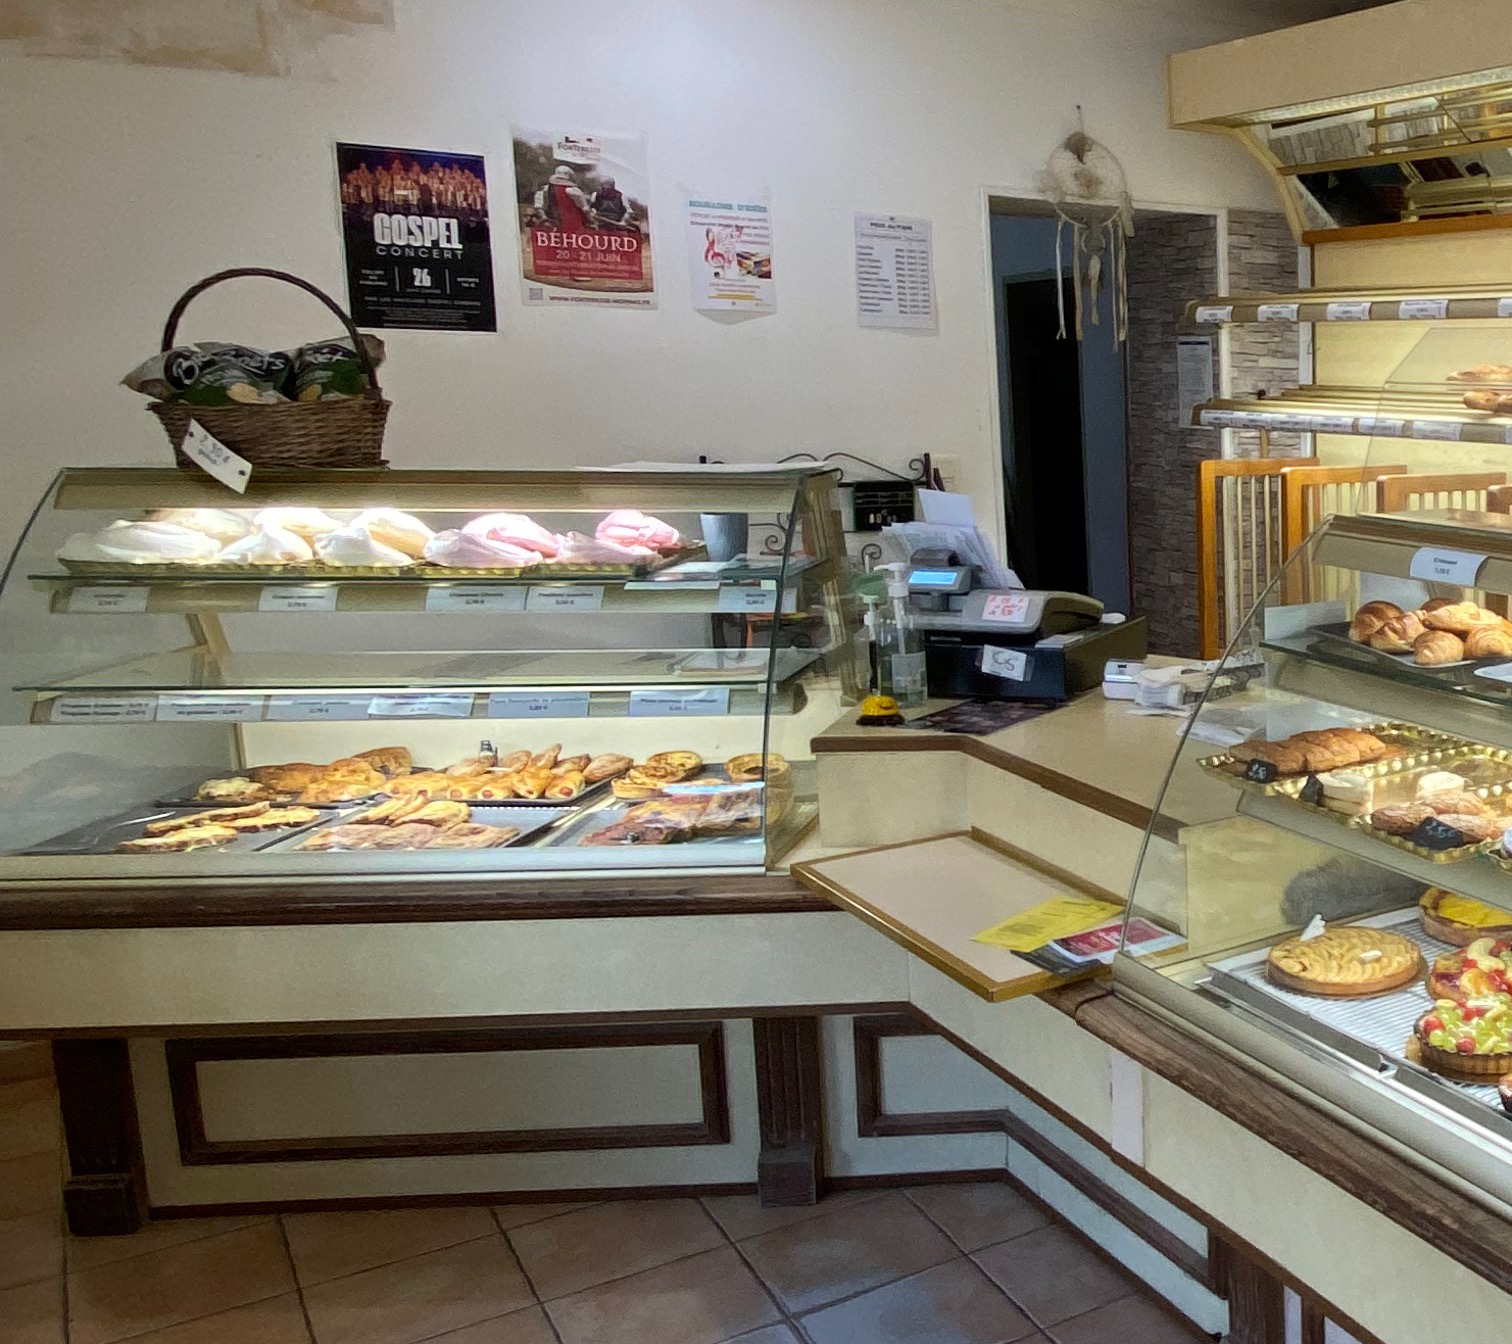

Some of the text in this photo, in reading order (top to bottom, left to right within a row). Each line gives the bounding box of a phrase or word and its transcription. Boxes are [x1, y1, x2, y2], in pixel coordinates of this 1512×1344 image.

[373, 212, 464, 249] GOSPEL
[536, 227, 638, 252] BÉHOURD
[376, 246, 464, 260] CONCERT
[556, 250, 570, 260] 20
[579, 251, 591, 261] 21
[596, 252, 621, 263] JUIN
[412, 267, 432, 287] 26
